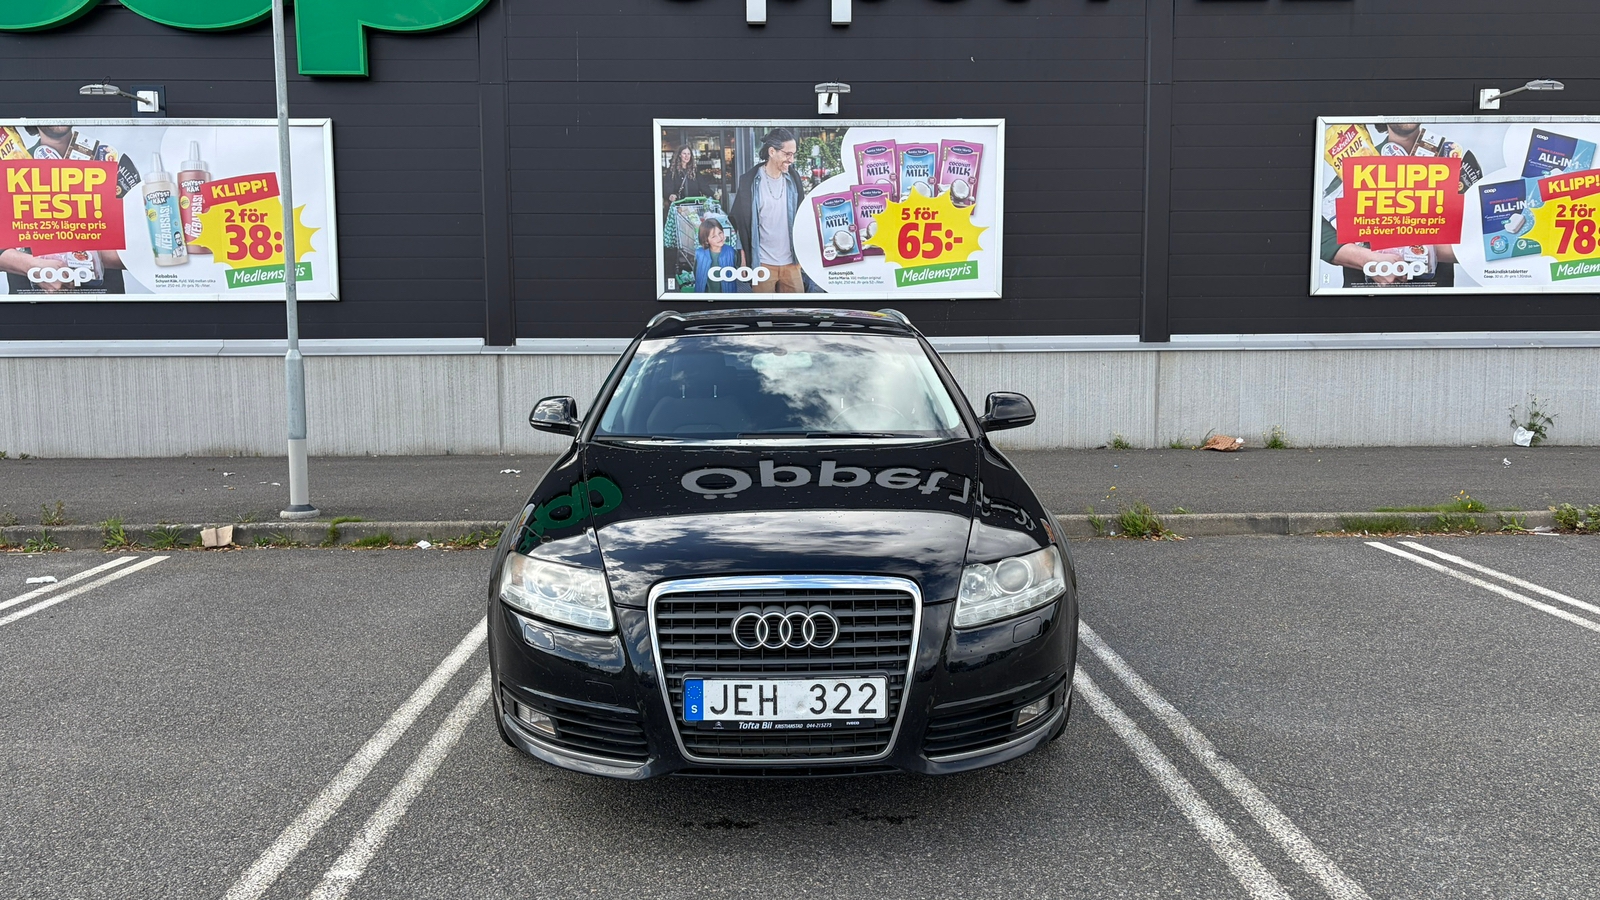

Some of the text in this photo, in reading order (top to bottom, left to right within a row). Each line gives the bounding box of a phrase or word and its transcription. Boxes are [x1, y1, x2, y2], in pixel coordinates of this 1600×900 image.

[1334, 136, 1363, 170] SATADE
[1538, 152, 1580, 170] ALL-IN-1
[6, 167, 107, 193] KLIPP
[866, 166, 890, 177] MILK
[905, 169, 929, 177] MILK
[947, 166, 971, 176] MILK
[1353, 164, 1450, 189] KLIPP
[211, 179, 268, 199] KLIPP!
[1548, 174, 1600, 193] KLIPP!
[13, 194, 103, 219] FEST!
[1356, 190, 1444, 214] FEST!
[1494, 199, 1536, 213] ALL-IN-1
[1556, 204, 1596, 218] 2 för
[224, 208, 268, 223] 2 för
[825, 217, 848, 229] MILK
[901, 207, 939, 221] 5 för
[1353, 216, 1446, 226] Minst 25% lägre pris
[12, 221, 106, 231] Minst 25% lägre pris
[1359, 226, 1371, 236] på
[1373, 226, 1394, 235] över
[1396, 226, 1413, 235] 100
[19, 231, 31, 241] på
[32, 231, 54, 240] över
[56, 231, 73, 240] 100
[225, 224, 283, 261] 38:
[898, 222, 963, 259] 65:-
[1555, 219, 1600, 254] 78
[27, 266, 93, 287] coop
[233, 265, 306, 284] Medlemsis
[707, 266, 770, 285] coop
[901, 263, 972, 282] Medlemspris
[1363, 261, 1426, 280] coop
[1556, 262, 1600, 276] Medlem
[710, 683, 877, 716] JEH 322
[691, 705, 698, 713] S
[738, 721, 760, 730] Tofta
[761, 721, 773, 729] Bil
